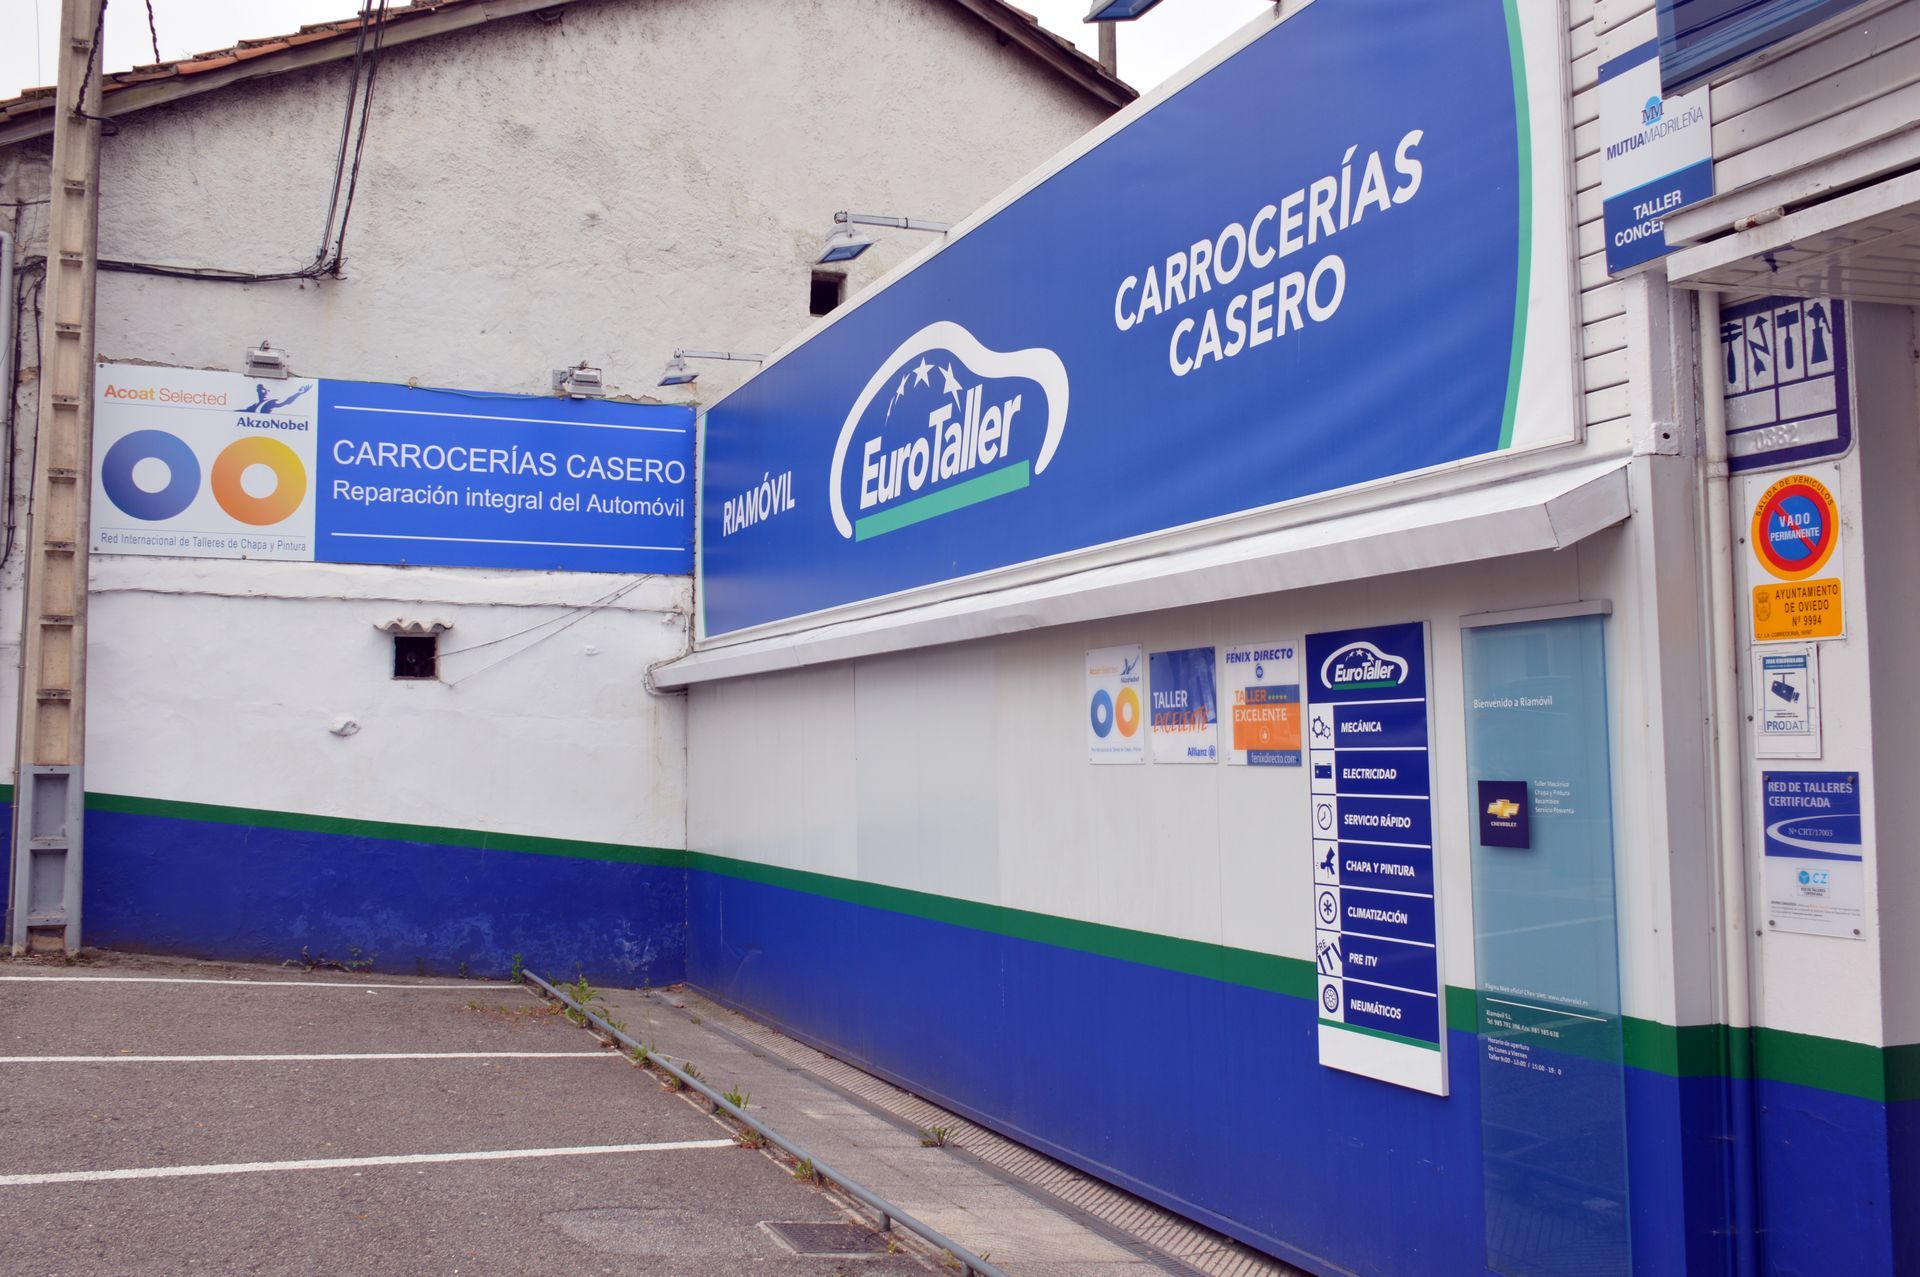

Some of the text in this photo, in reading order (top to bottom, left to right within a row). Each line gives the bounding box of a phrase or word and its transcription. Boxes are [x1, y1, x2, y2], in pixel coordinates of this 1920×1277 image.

[1633, 190, 1682, 220] TALLER
[1114, 129, 1424, 331] CARROCERÍAS
[1169, 254, 1347, 377] CASERO
[104, 384, 227, 406] Acoat Selected
[237, 417, 309, 432] AkzoNobel
[860, 383, 1022, 510] EuroTaller
[332, 439, 686, 484] CARROCERÍAS CASERO
[332, 479, 685, 517] Reparación integral del Automóvil
[723, 470, 795, 537] RIAMÓVIL
[1755, 475, 1834, 517] SALIDA DE VEHICULOS
[1779, 512, 1811, 528] VADO
[1770, 526, 1821, 542] PERMANENTE
[101, 532, 306, 553] Red Internacional de Talleres de Chapa y Pintura
[1775, 584, 1838, 600] AYUNTAMIENTO
[1784, 599, 1830, 613] DE OVIEDO
[1803, 615, 1822, 626] 9994
[1254, 647, 1293, 662] DIRECTO
[1334, 659, 1395, 682] EuroTaller
[1153, 690, 1188, 709] TALLER
[1235, 688, 1267, 703] TALLER
[1473, 697, 1513, 709] Bienvenido
[1520, 695, 1553, 706] Riamóvil
[1235, 708, 1287, 722] EXCELENTE
[1341, 719, 1382, 733] MECÁNICA
[1766, 720, 1805, 731] PRODAT
[1187, 746, 1207, 757] Allianz
[1343, 768, 1397, 780] ELECTRICIDAD
[1768, 781, 1853, 794] RED DE TALLERES
[1768, 796, 1831, 808] CERTIFICADA
[1344, 813, 1411, 829] SERVICIO RÁPIDO
[1345, 859, 1415, 878] CHAPA Y PINTURA
[1347, 905, 1408, 925] CLIMATIZACIÓN
[1349, 953, 1378, 968] PRE ITV
[1350, 998, 1402, 1020] NEUMÁTICOS
